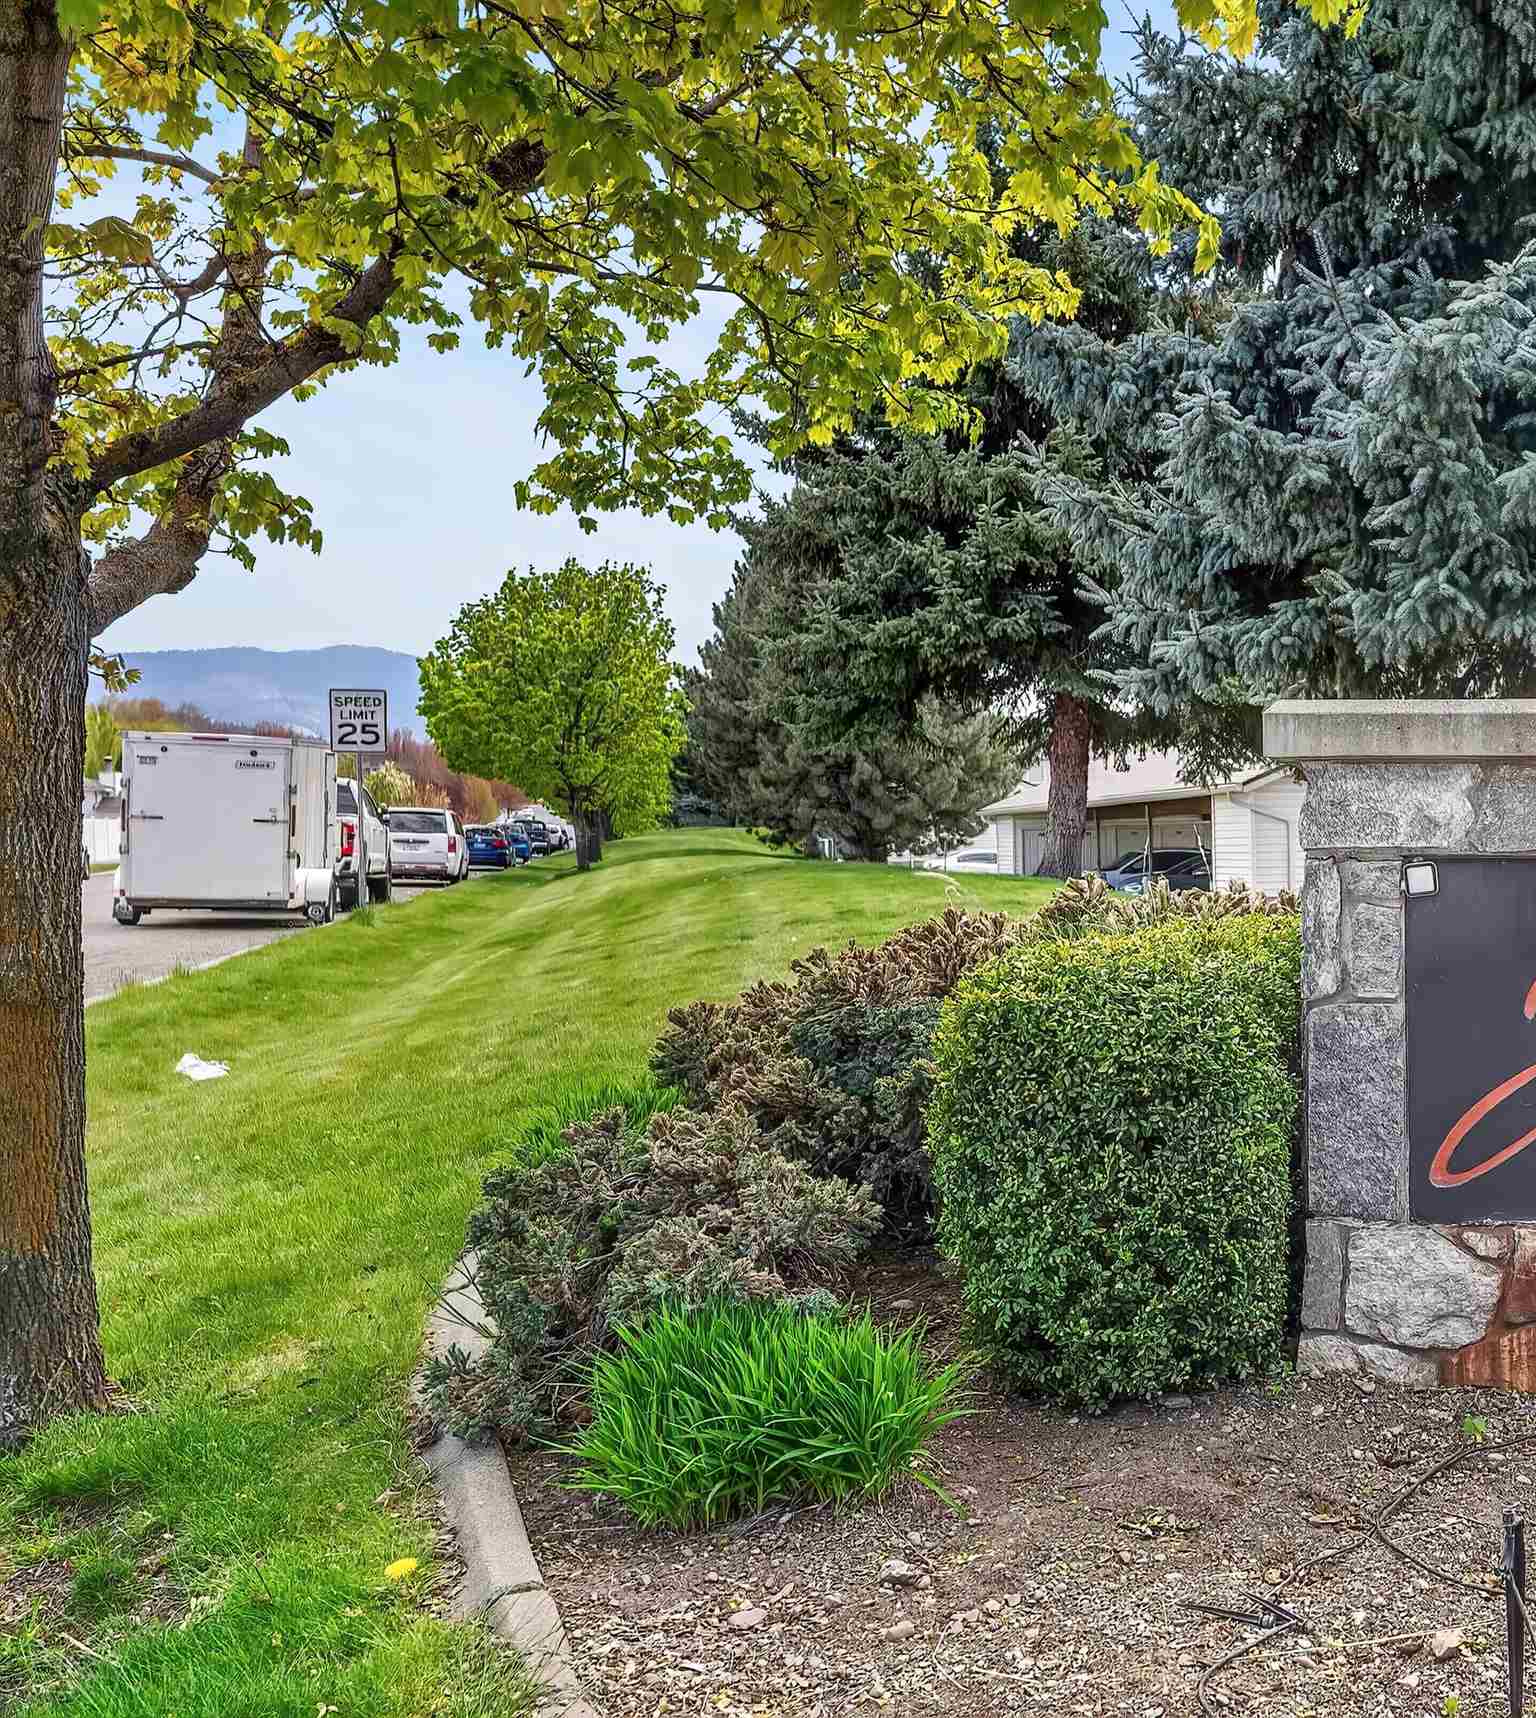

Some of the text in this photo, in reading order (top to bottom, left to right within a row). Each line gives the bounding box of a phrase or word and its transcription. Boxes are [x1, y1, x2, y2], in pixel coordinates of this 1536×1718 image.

[334, 696, 382, 707] SPEED
[340, 709, 376, 720] LIMIT
[338, 723, 380, 745] 25
